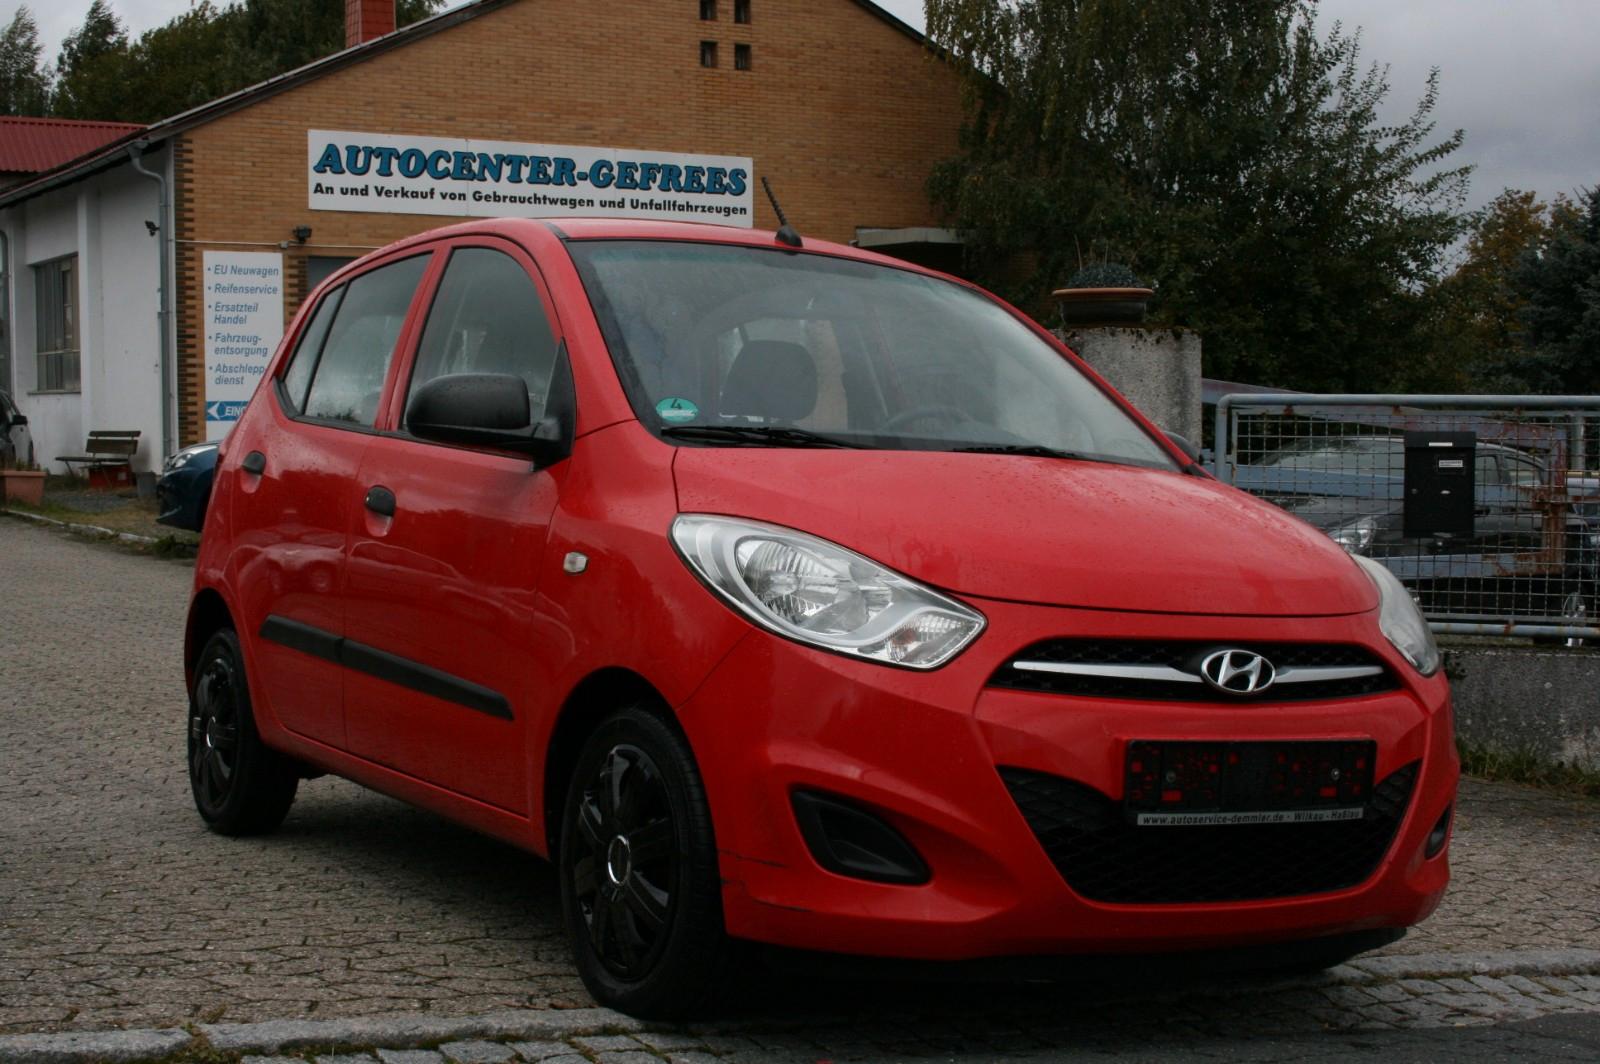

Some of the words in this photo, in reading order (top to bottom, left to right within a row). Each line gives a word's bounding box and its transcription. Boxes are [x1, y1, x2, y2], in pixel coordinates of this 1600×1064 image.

[313, 143, 748, 196] AUTOCENTER-GEFREES
[313, 183, 334, 195] An
[340, 185, 369, 197] und
[374, 186, 435, 200] Verkauf
[440, 192, 467, 202] von
[472, 190, 595, 209] Gebrauchtwagen
[599, 197, 625, 209] und
[630, 198, 748, 217] Unfallfahrzeugen
[214, 264, 228, 275] EU
[230, 265, 279, 279] Neuwagen
[214, 283, 278, 295] Reifenservice
[214, 302, 259, 313] Ersatzteil
[214, 314, 247, 325] Handel
[214, 332, 262, 346] Fahrzeug-
[214, 346, 268, 357] entsorgung
[214, 376, 245, 385] dienst
[670, 398, 682, 410] 4
